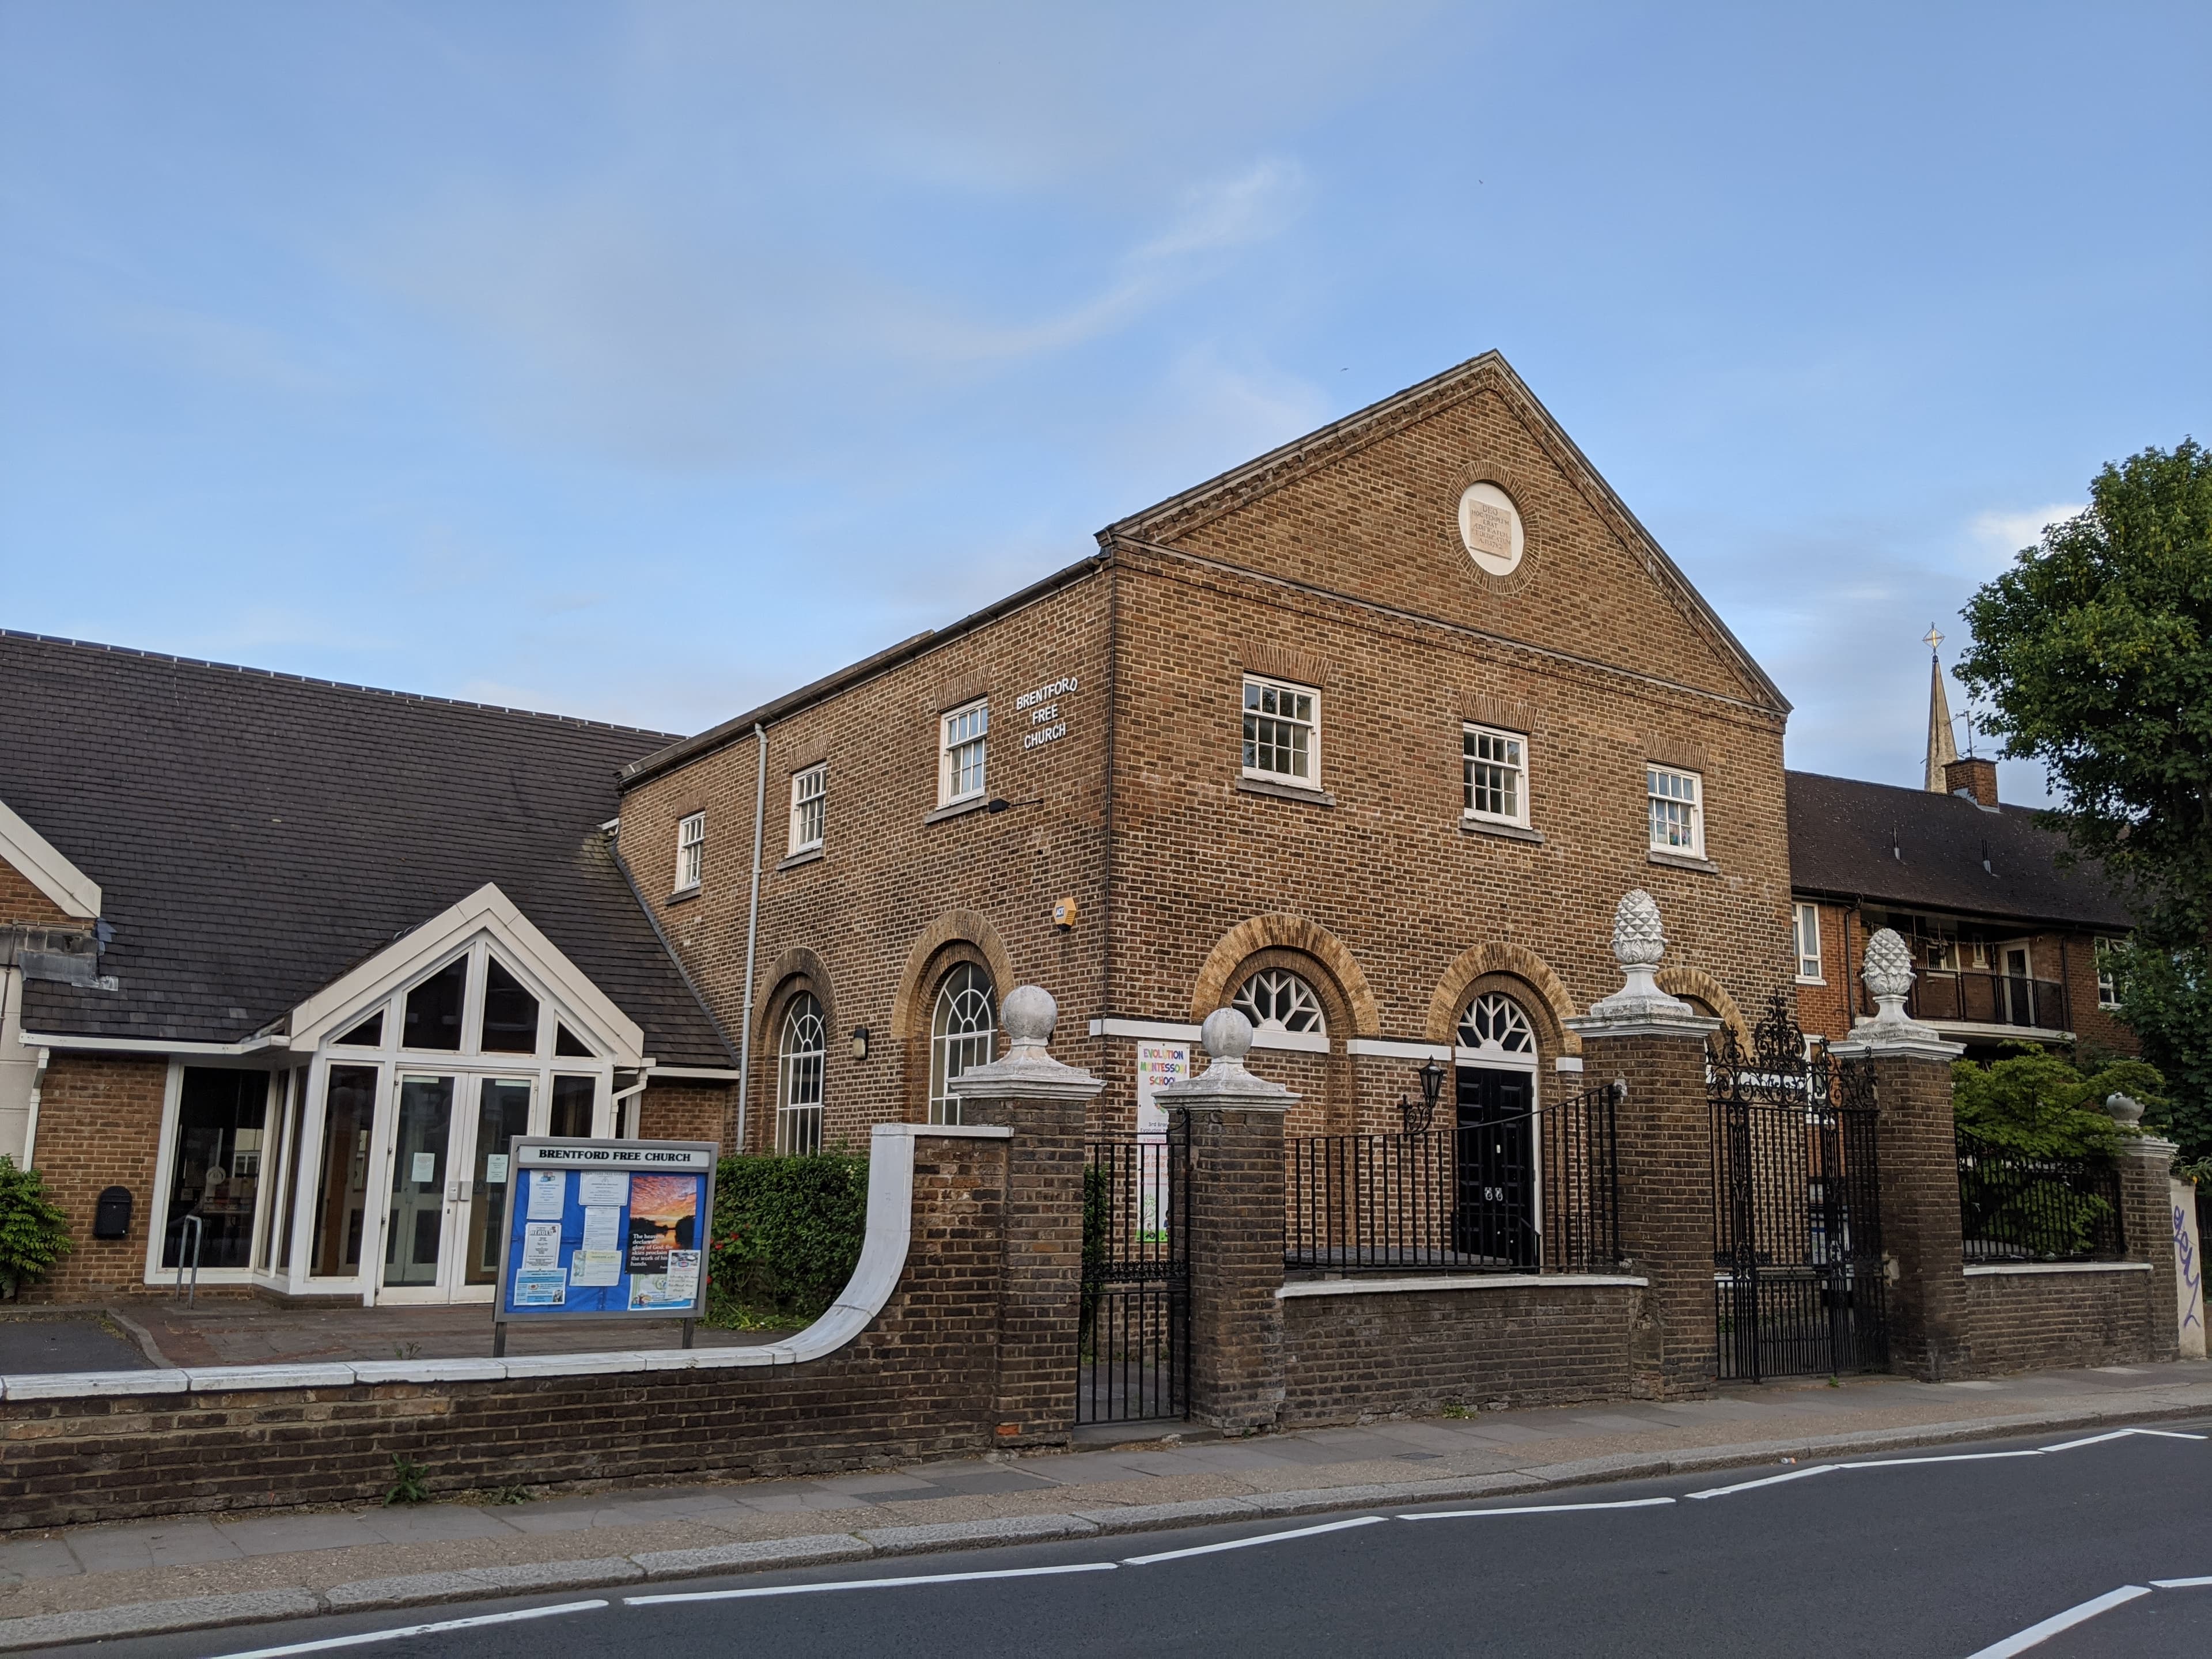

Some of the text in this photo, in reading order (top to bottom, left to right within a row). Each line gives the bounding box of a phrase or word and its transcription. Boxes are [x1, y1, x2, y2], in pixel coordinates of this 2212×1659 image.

[1483, 505, 1498, 516] DEO
[1017, 676, 1078, 710] BRENTFORD
[1032, 703, 1059, 725] FREE
[1024, 722, 1066, 749] CHURCH
[1143, 1048, 1184, 1060] EVOLUTION
[1140, 1061, 1187, 1074] MONTESSORI
[1149, 1075, 1176, 1086] SCHOO
[539, 1149, 691, 1162] BRENTFORD FREE CHURCH
